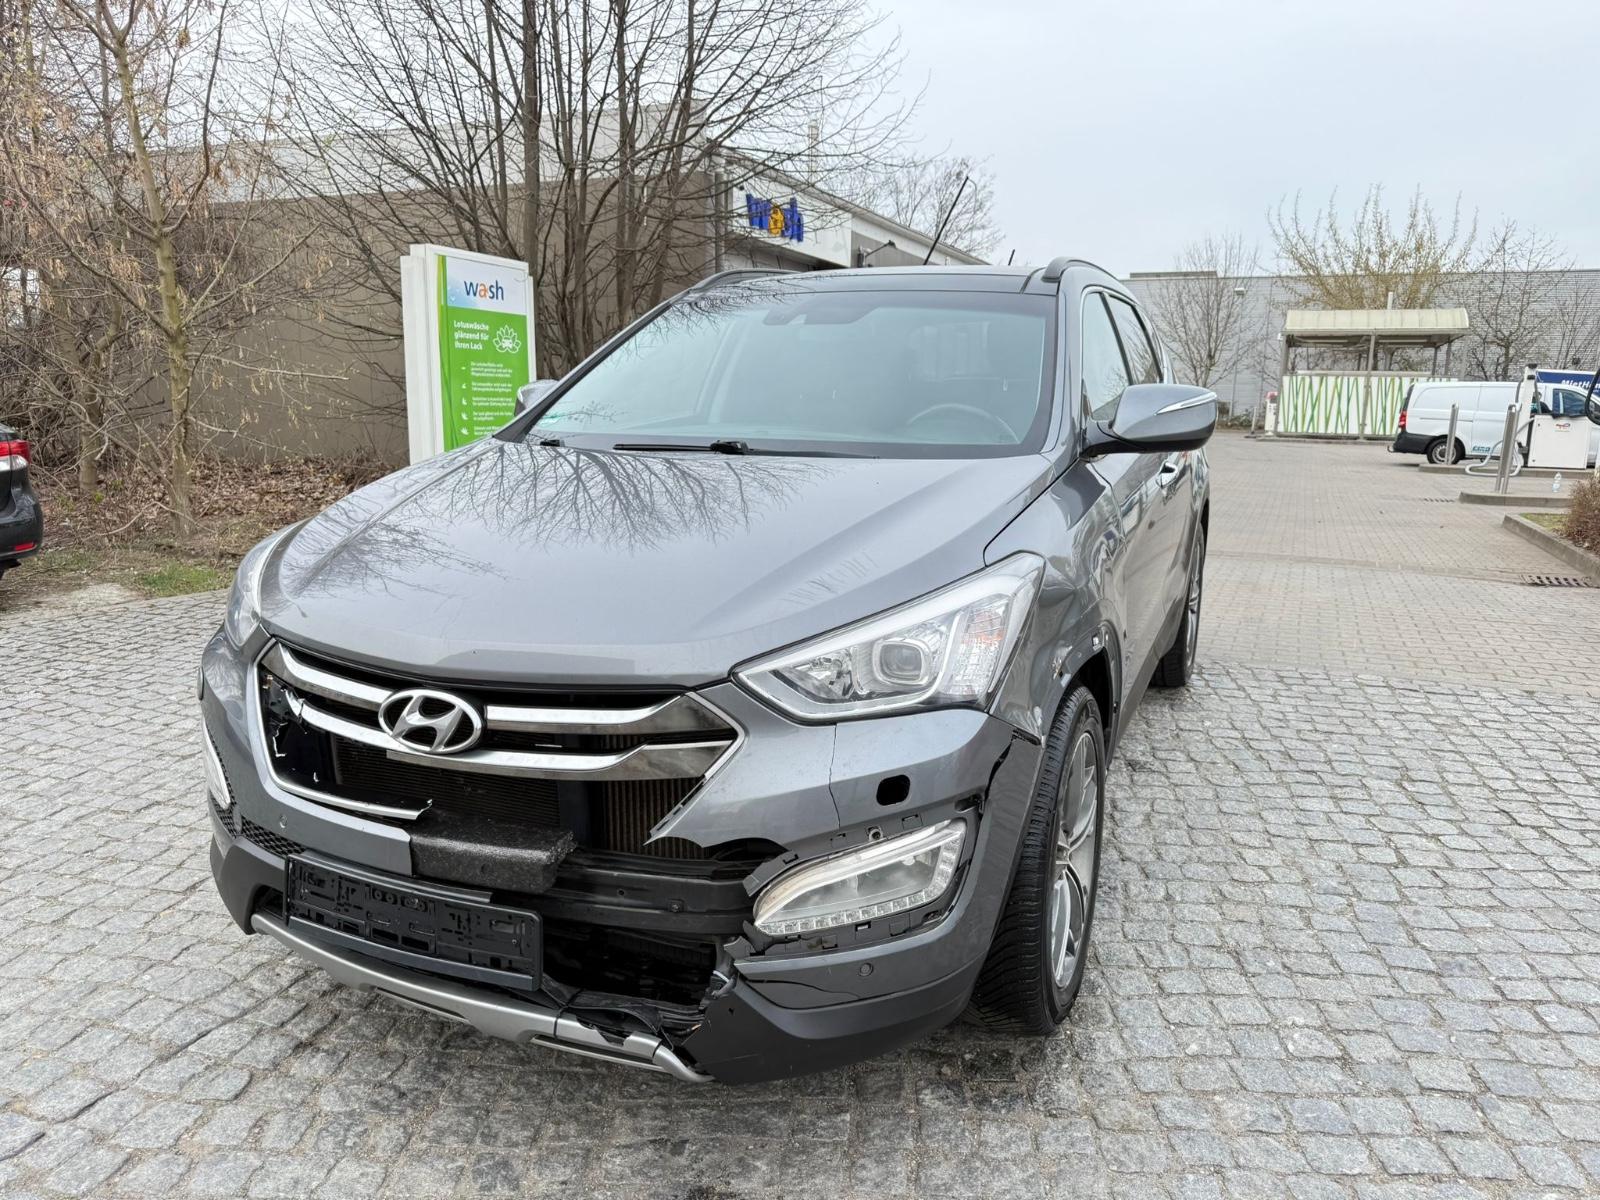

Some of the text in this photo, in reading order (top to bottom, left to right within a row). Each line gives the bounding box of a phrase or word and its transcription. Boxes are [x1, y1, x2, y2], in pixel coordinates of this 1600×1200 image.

[464, 279, 504, 301] wash
[453, 320, 489, 331] Lotuswäsche
[454, 330, 489, 340] glänzend für
[455, 341, 482, 350] Ihren Lack
